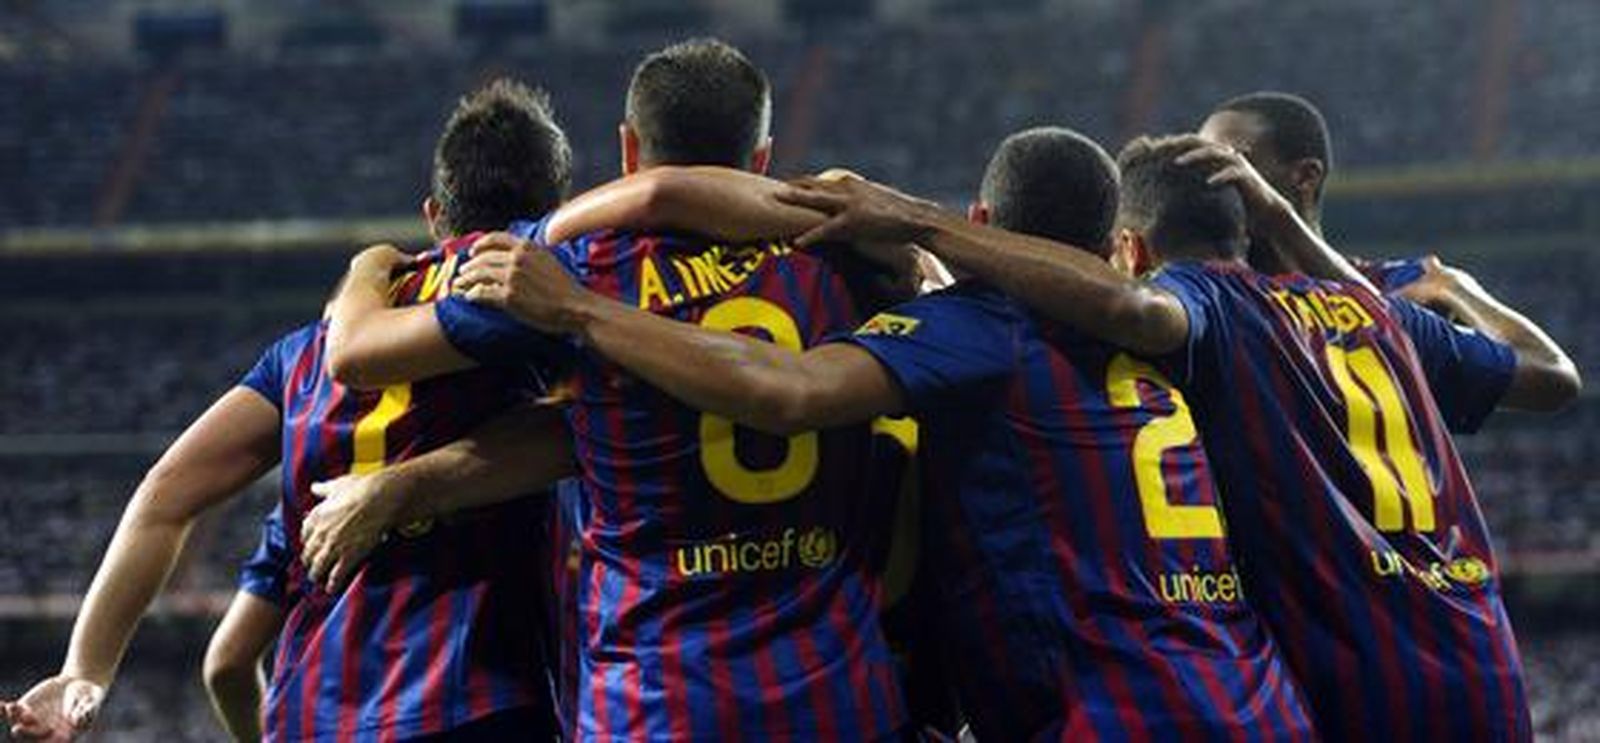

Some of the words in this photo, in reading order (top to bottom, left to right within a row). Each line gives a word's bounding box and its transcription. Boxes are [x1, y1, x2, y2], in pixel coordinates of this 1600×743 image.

[1106, 353, 1227, 539] 2
[1326, 343, 1436, 533] 11
[677, 527, 796, 576] unicef
